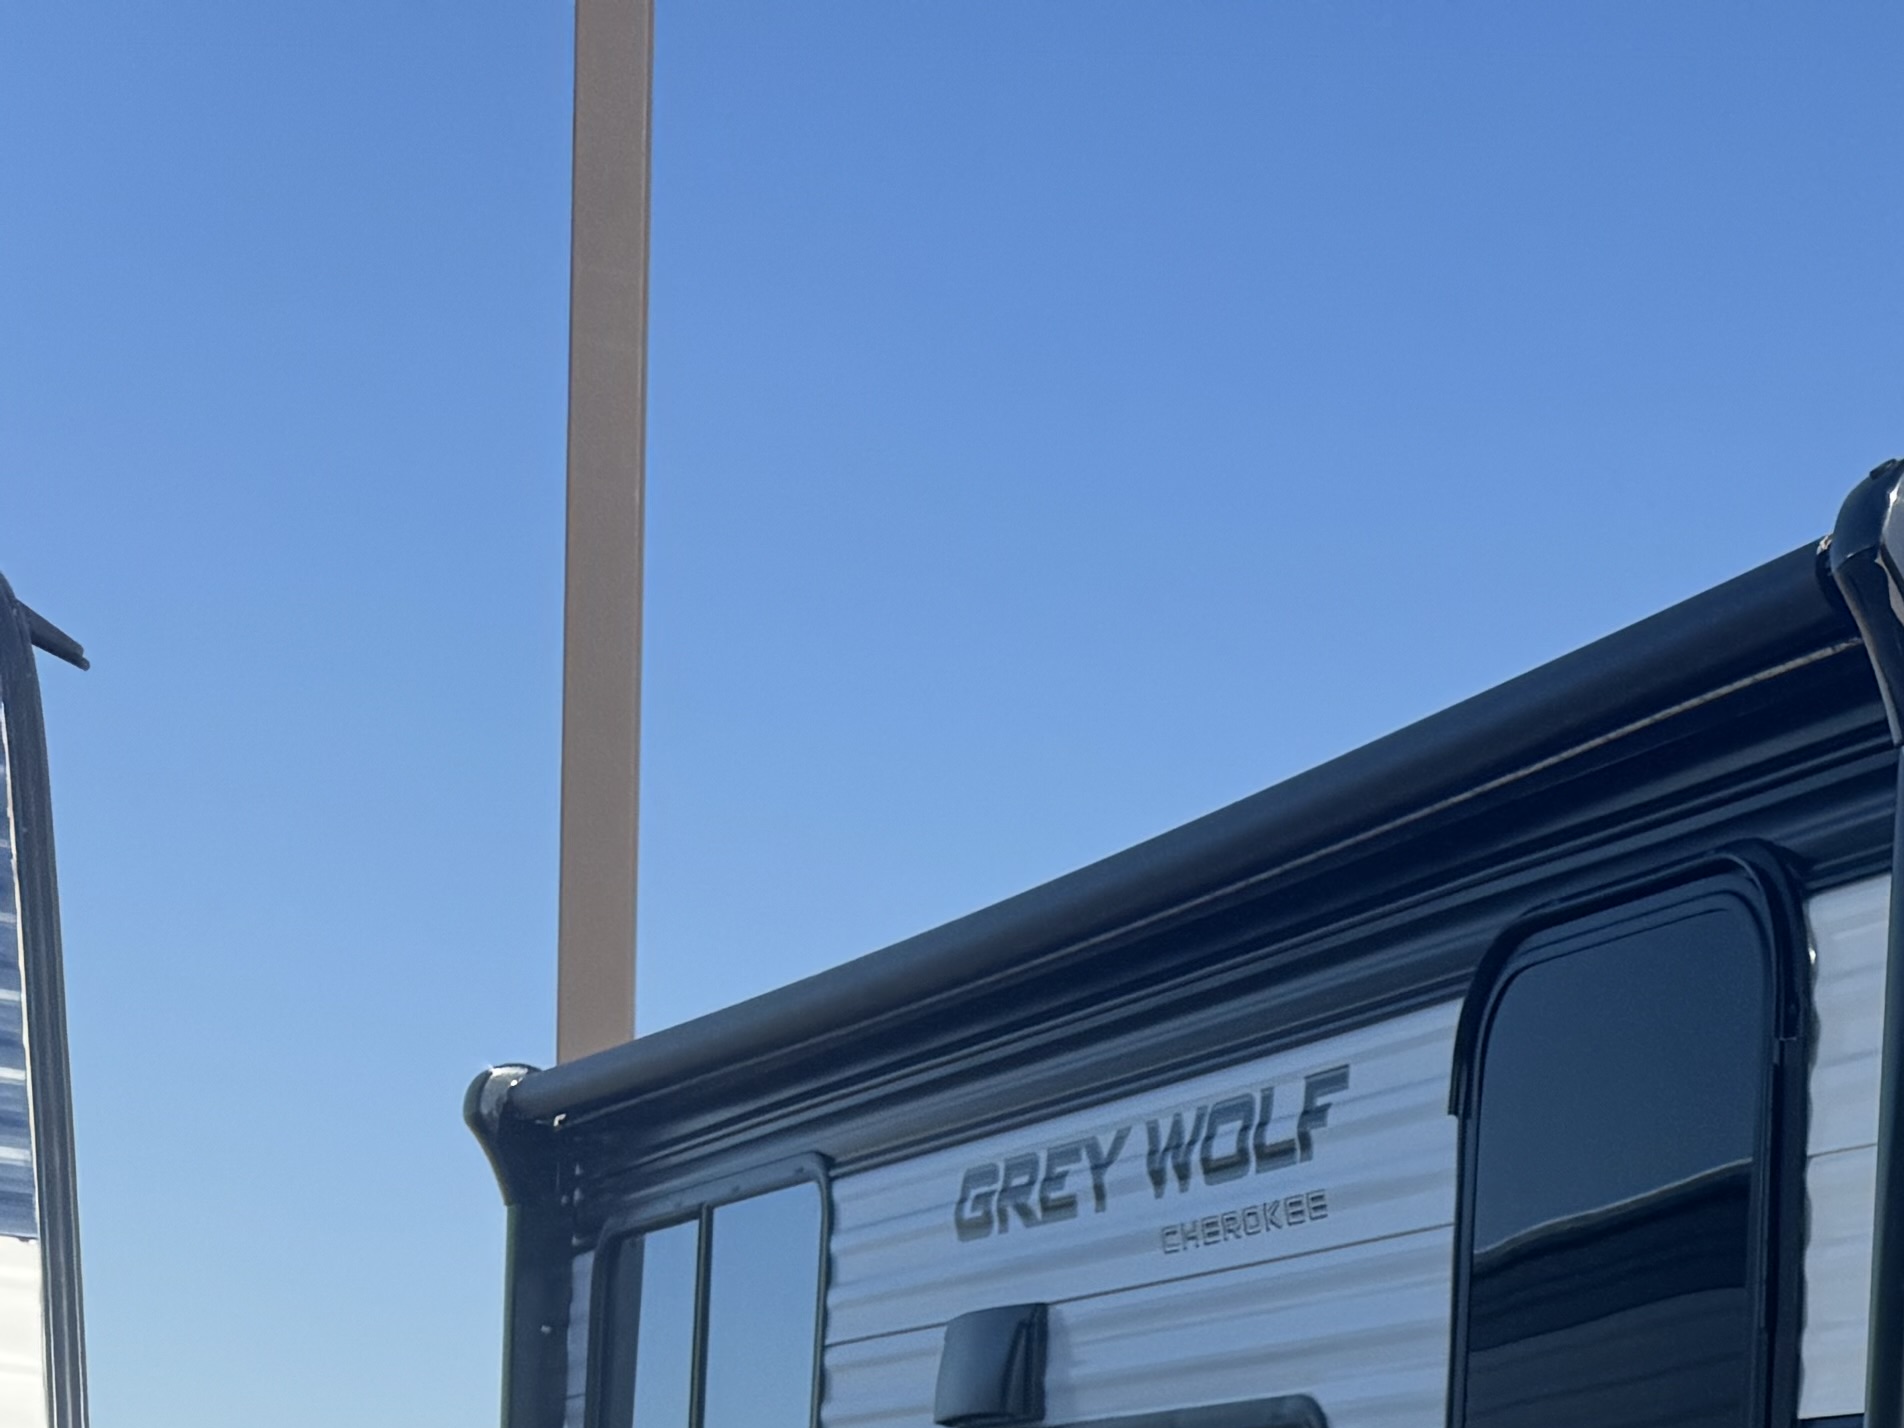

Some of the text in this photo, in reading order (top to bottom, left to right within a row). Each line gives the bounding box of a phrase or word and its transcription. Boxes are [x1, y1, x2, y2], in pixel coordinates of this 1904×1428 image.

[954, 1063, 1350, 1243] GREY WOLF
[1161, 1188, 1328, 1255] CHEROKEE
